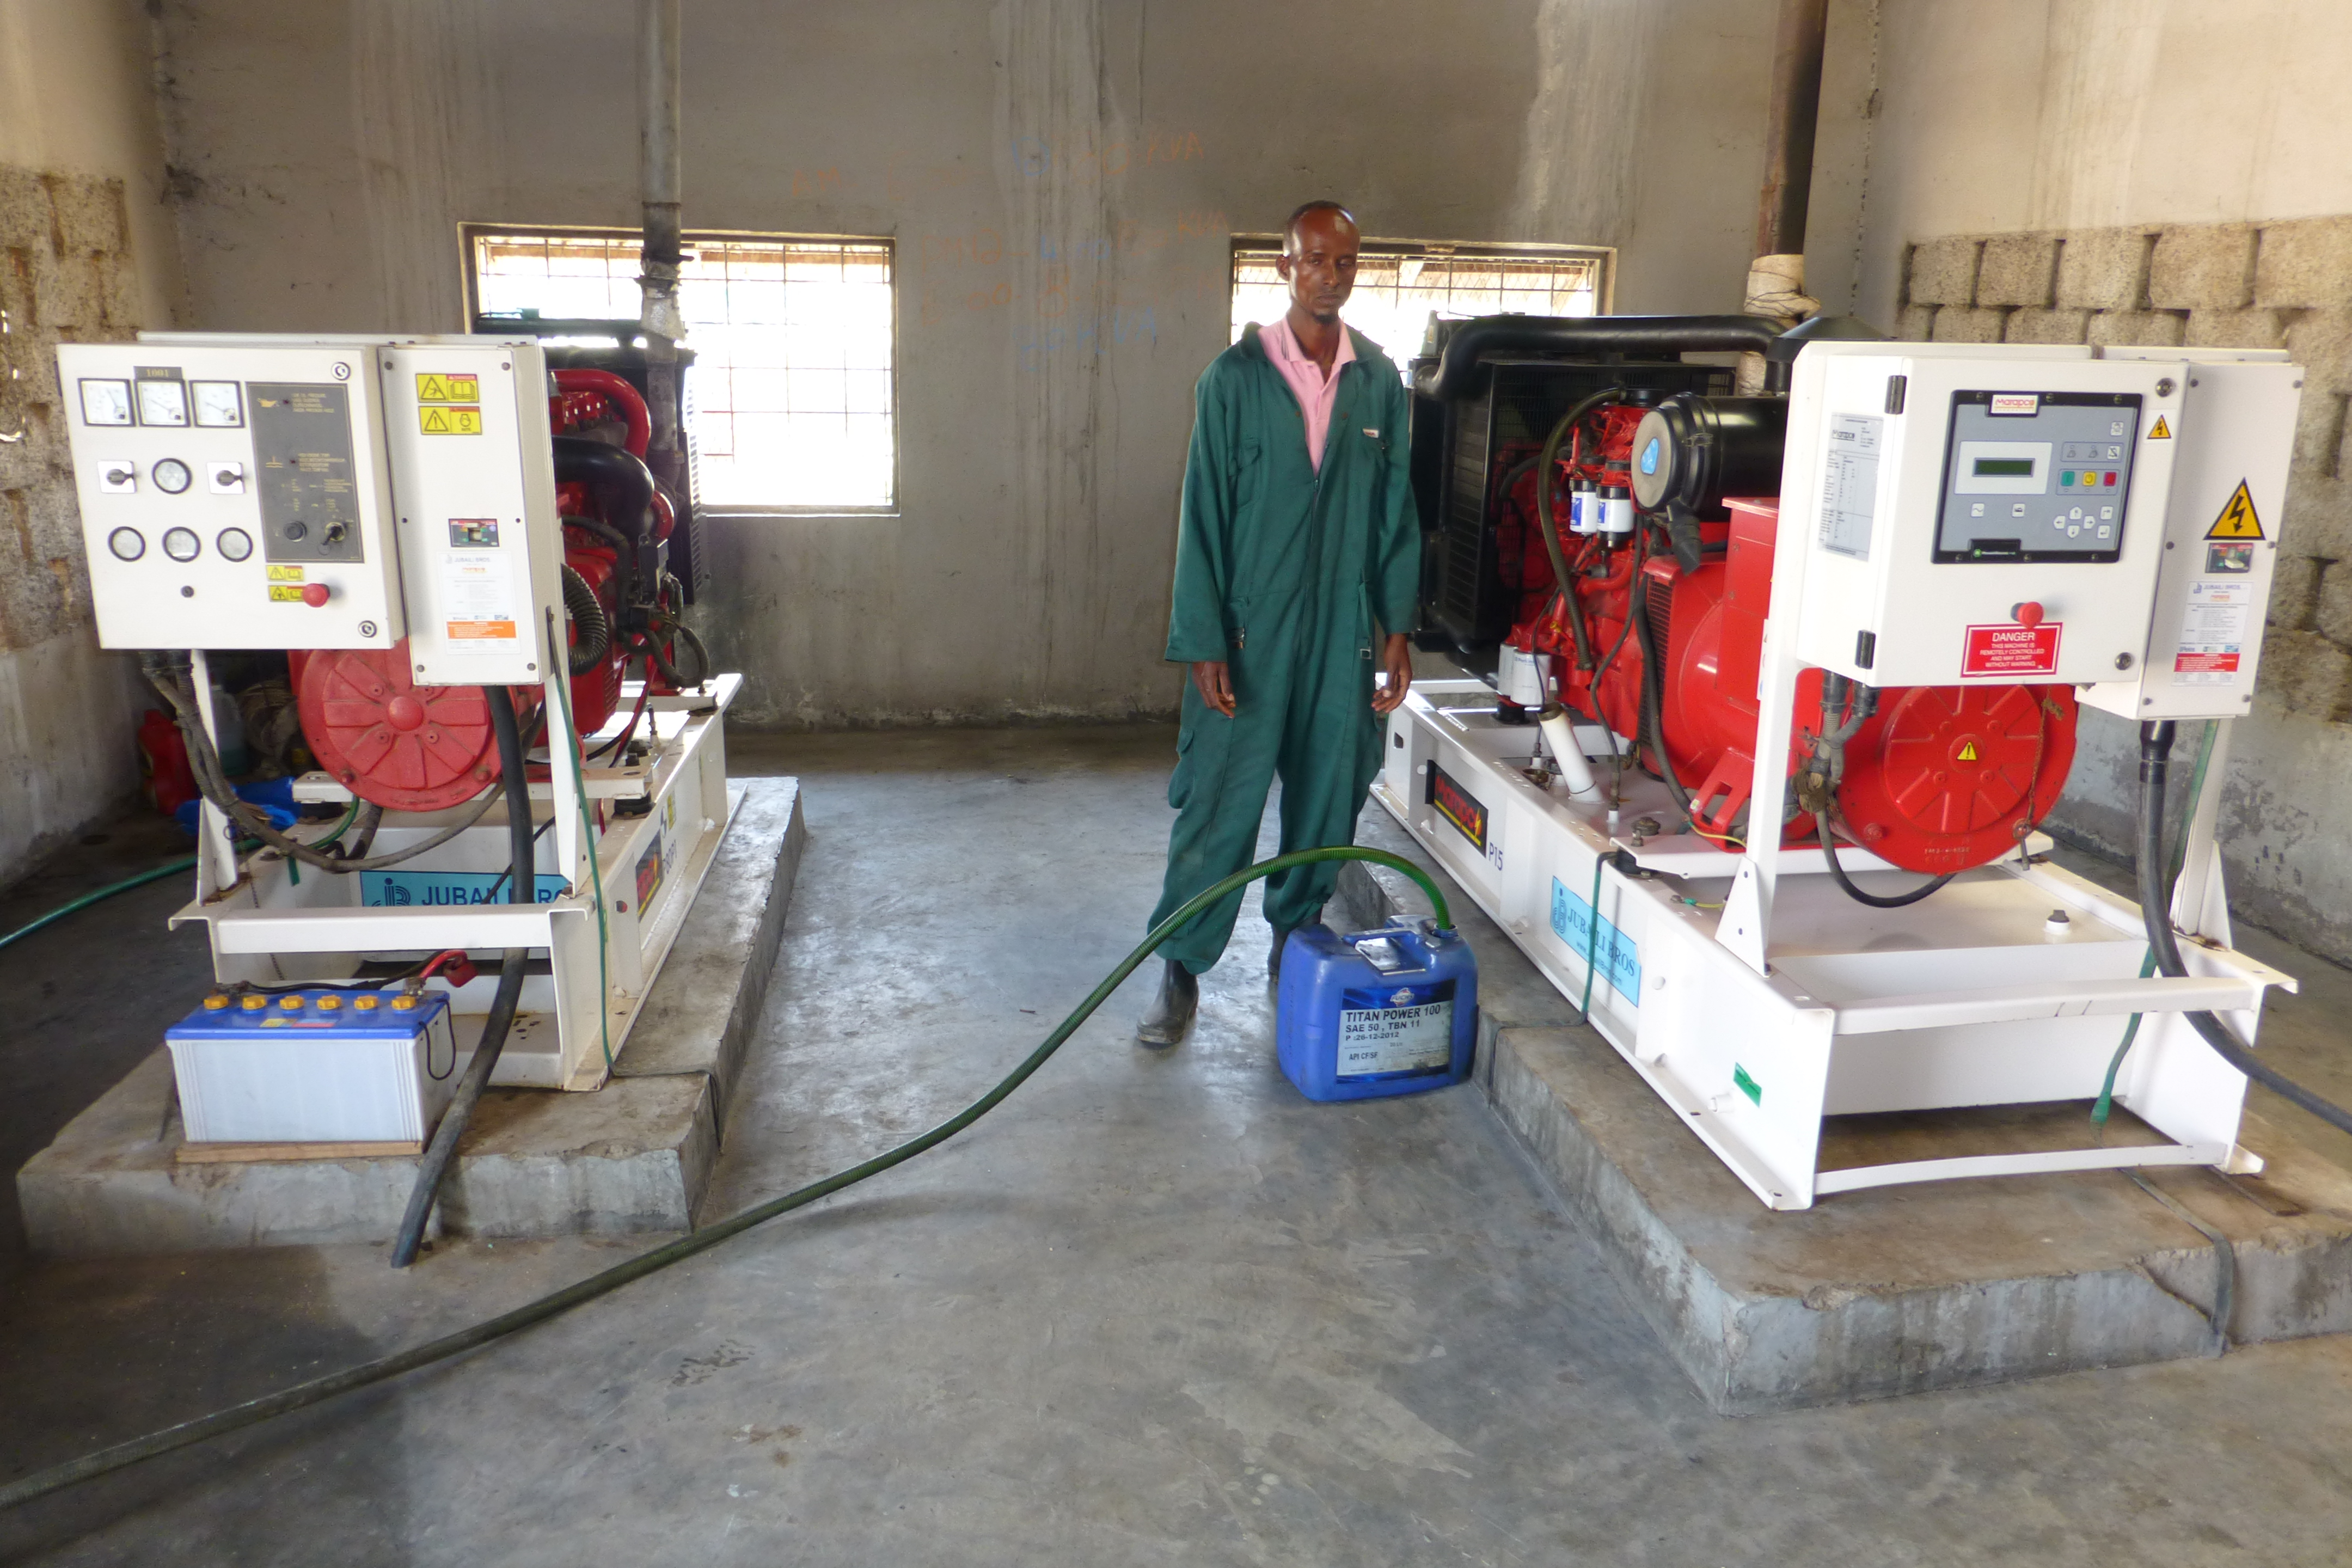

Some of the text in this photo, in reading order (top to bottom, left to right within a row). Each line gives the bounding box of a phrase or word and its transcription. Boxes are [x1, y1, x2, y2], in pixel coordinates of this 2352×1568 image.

[1992, 632, 2035, 641] DANGER
[1568, 908, 1606, 952] JUBALI
[1608, 940, 1635, 976] BROS
[1346, 1004, 1441, 1022] TITAN POWER 100
[1346, 1024, 1365, 1032] SAE
[1368, 1023, 1379, 1031] 50
[1388, 1021, 1407, 1030] TBN
